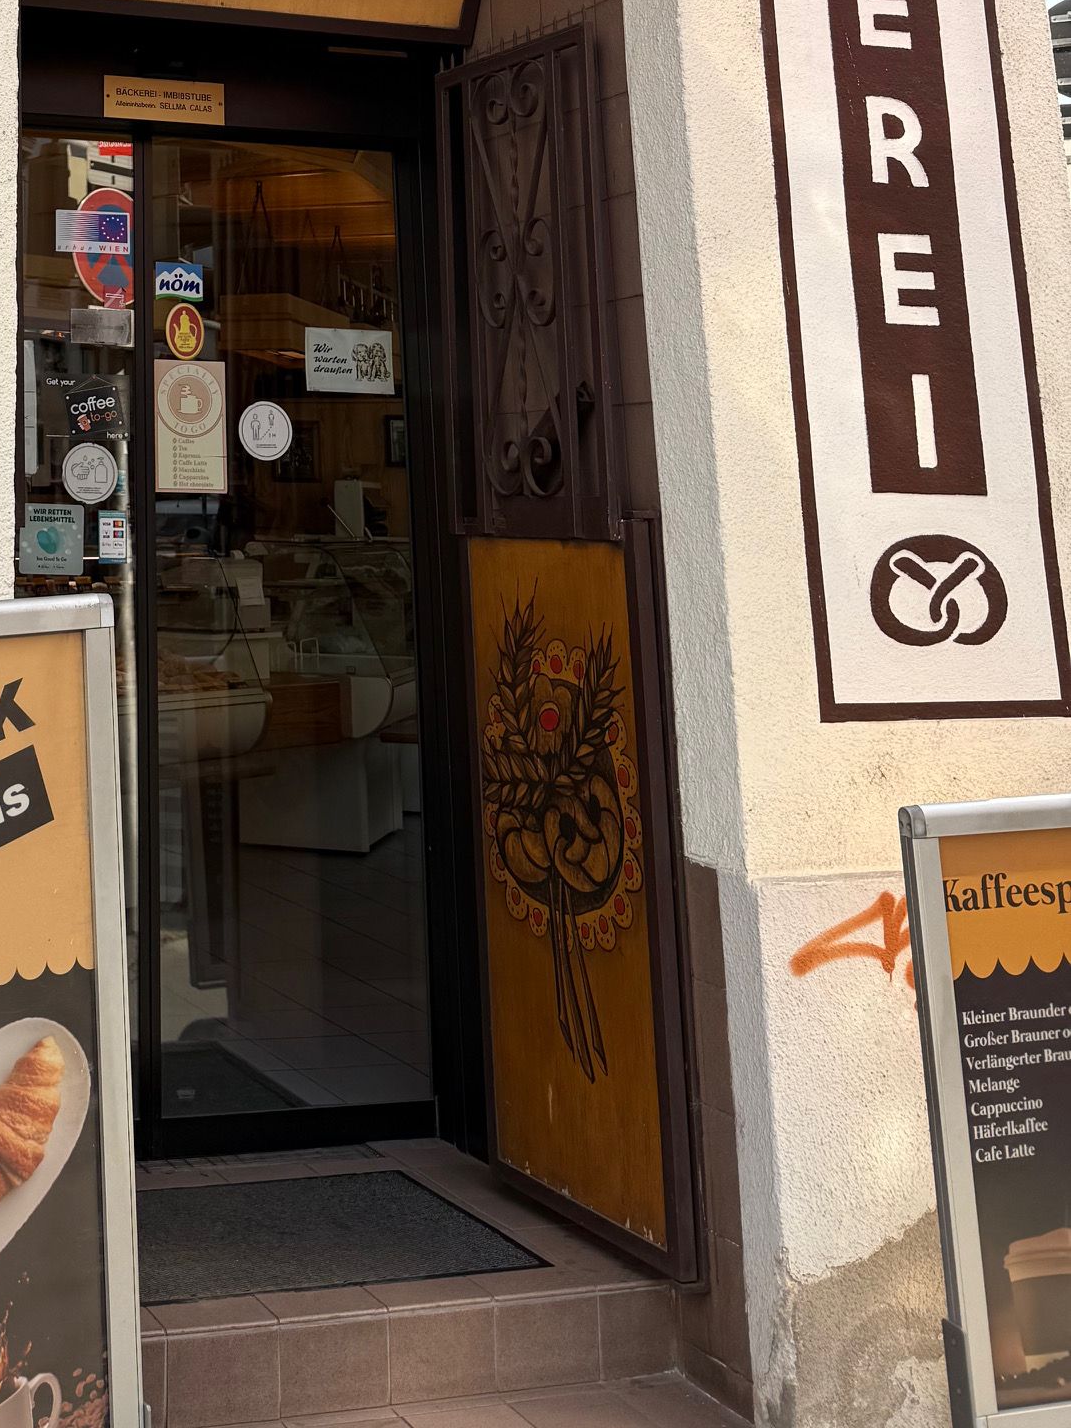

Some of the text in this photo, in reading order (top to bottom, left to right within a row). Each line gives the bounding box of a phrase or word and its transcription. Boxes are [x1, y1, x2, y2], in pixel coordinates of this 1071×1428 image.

[116, 86, 157, 98] BÄCKEREI
[190, 104, 213, 113] CALAS
[99, 245, 129, 253] WIEN
[158, 274, 201, 294] nöm
[313, 343, 333, 353] Wir
[313, 355, 348, 364] warten
[313, 364, 353, 375] draußen
[46, 378, 76, 387] Get your
[70, 396, 116, 415] coffee
[90, 410, 118, 421] to-go
[48, 508, 72, 516] RETTEN
[29, 516, 76, 524] LEBENSMITTEL
[943, 872, 1071, 914] Kaffeesp
[962, 1009, 1006, 1026] Kleiner
[1008, 1002, 1067, 1021] Braunder
[964, 1030, 1009, 1048] Großer
[1011, 1028, 1061, 1044] Brauner
[966, 1053, 1042, 1071] Verlängerter
[969, 1077, 1021, 1094] Melange
[971, 1097, 1044, 1119] Cappuccino
[973, 1117, 1049, 1140] Häferlkaffee
[975, 1144, 1036, 1163] Cafe Latte
